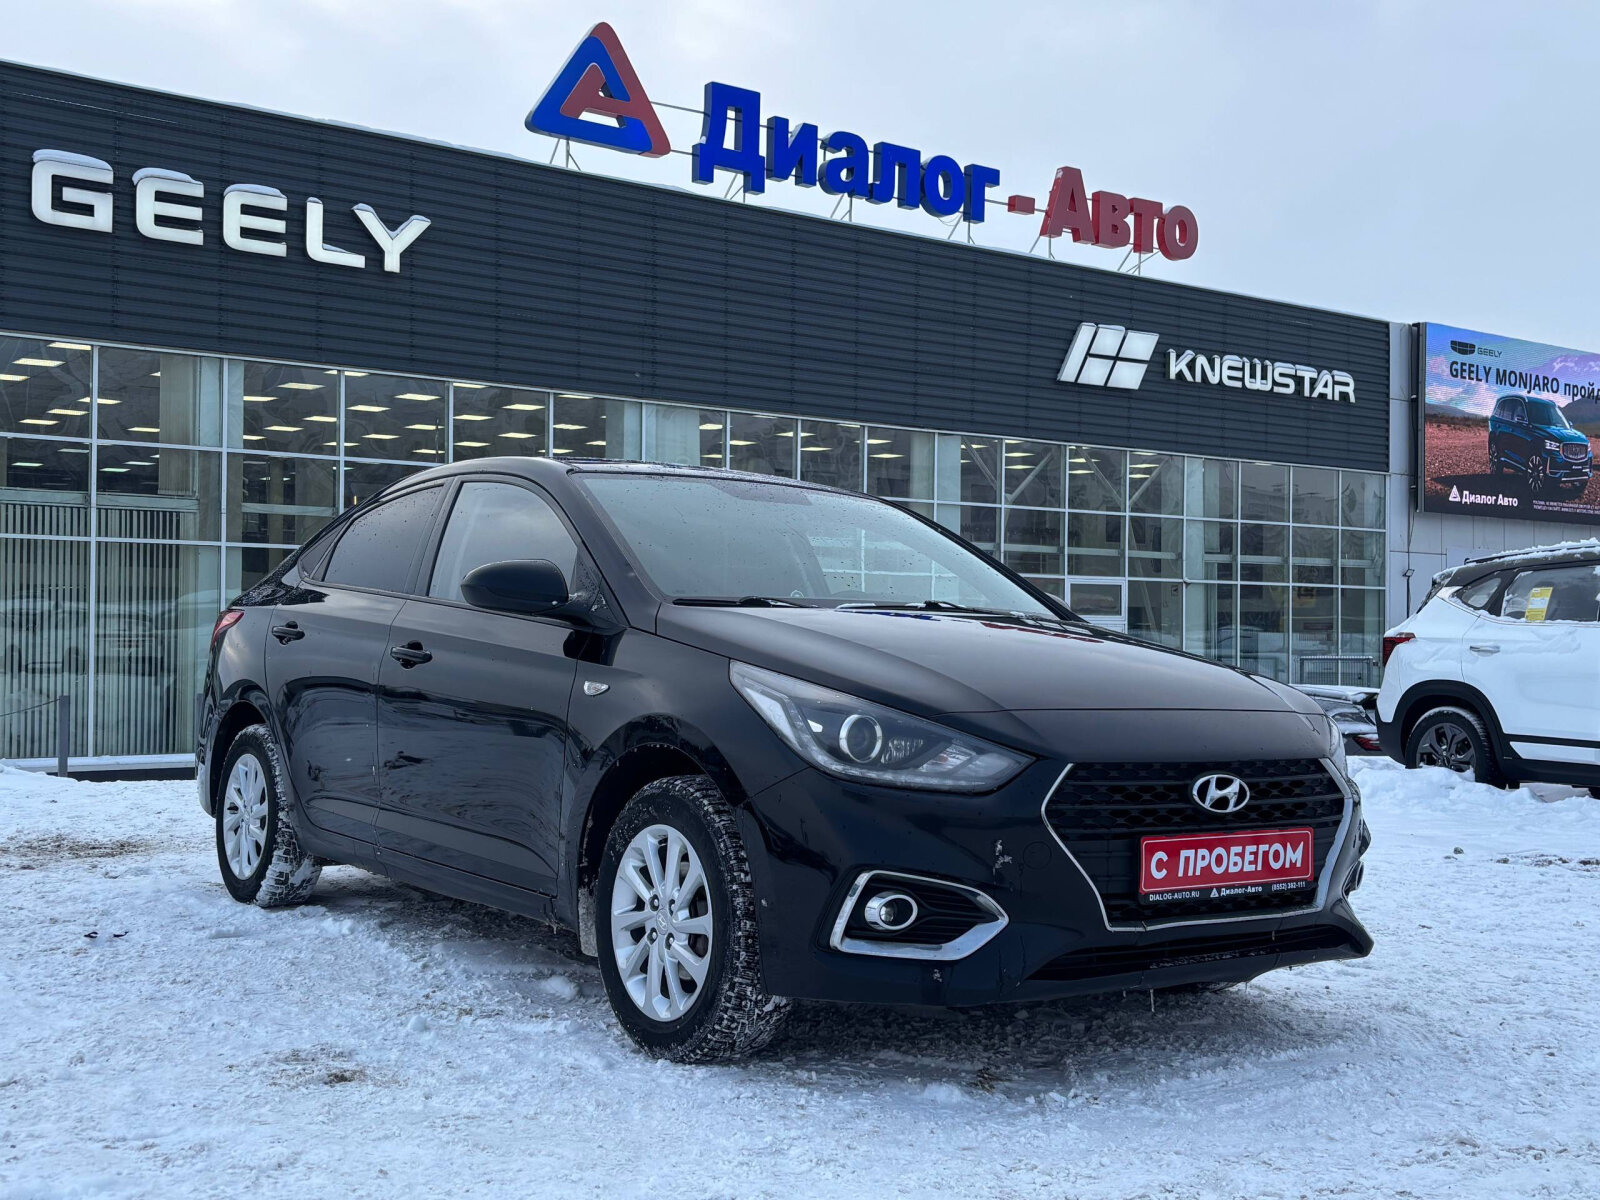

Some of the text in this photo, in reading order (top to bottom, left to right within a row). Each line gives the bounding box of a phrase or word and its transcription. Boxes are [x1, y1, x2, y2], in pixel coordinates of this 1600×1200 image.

[31, 154, 432, 273] GEELY
[1477, 347, 1503, 358] GEELY
[1167, 350, 1356, 403] KNEWSTAR
[1450, 360, 1492, 384] GEELY
[1495, 368, 1560, 394] MONJARO
[1462, 490, 1497, 505] Диалог
[1497, 493, 1519, 507] Авто
[1150, 841, 1304, 880] С ПРОБЕГОМ
[1149, 890, 1200, 901] DIALOG-AUTO.RU
[1220, 885, 1263, 897] Диалог-Авто
